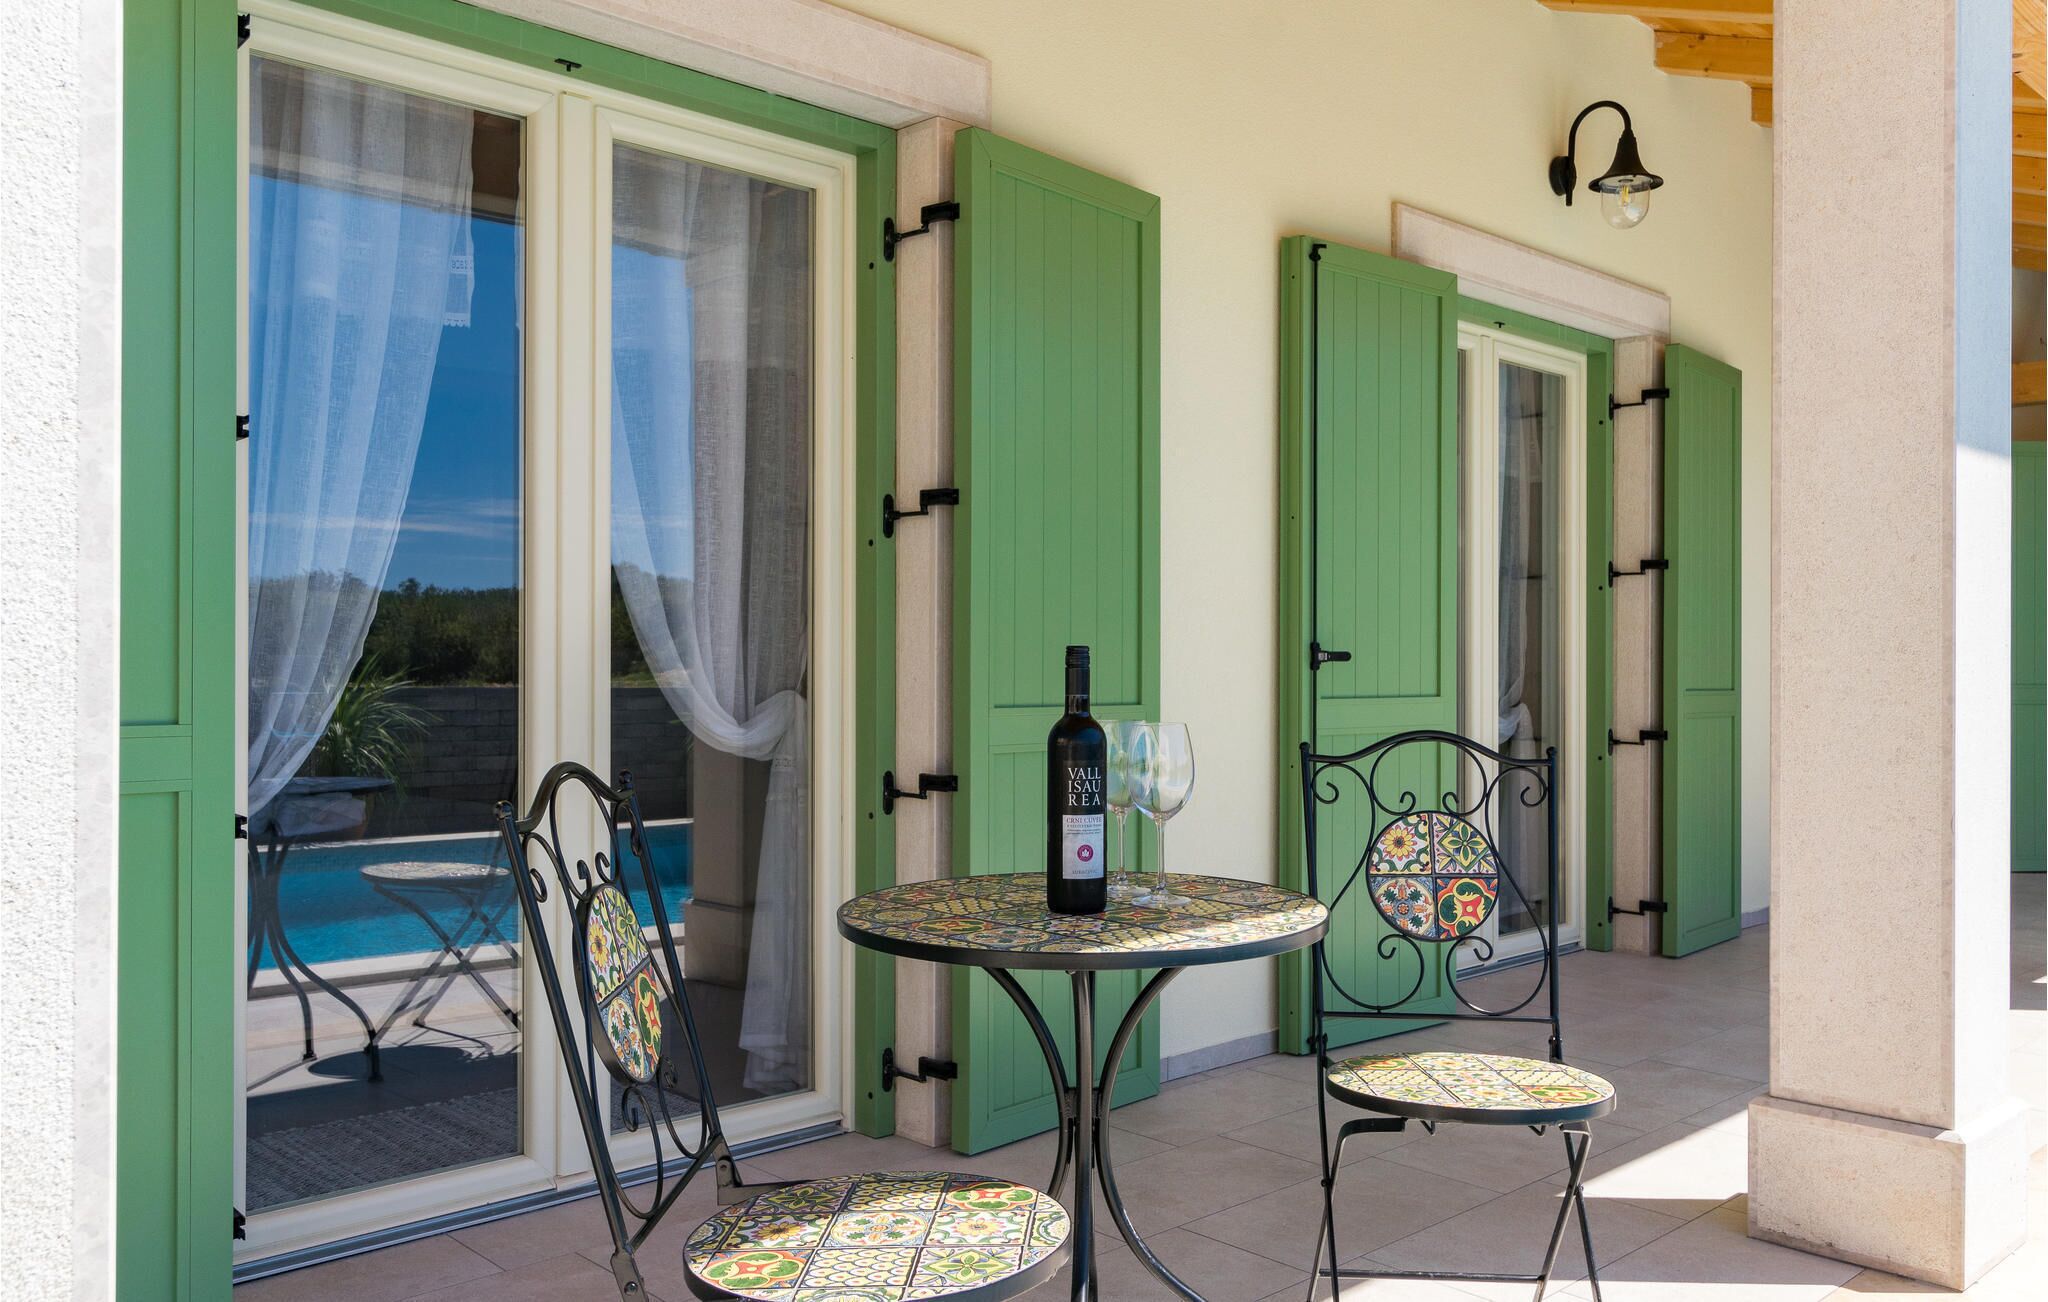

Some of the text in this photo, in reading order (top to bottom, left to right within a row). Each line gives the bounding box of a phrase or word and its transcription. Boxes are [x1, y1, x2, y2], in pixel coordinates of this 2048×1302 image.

[1068, 767, 1101, 780] VALL
[1068, 780, 1101, 793] ISAU
[1068, 793, 1101, 806] REA
